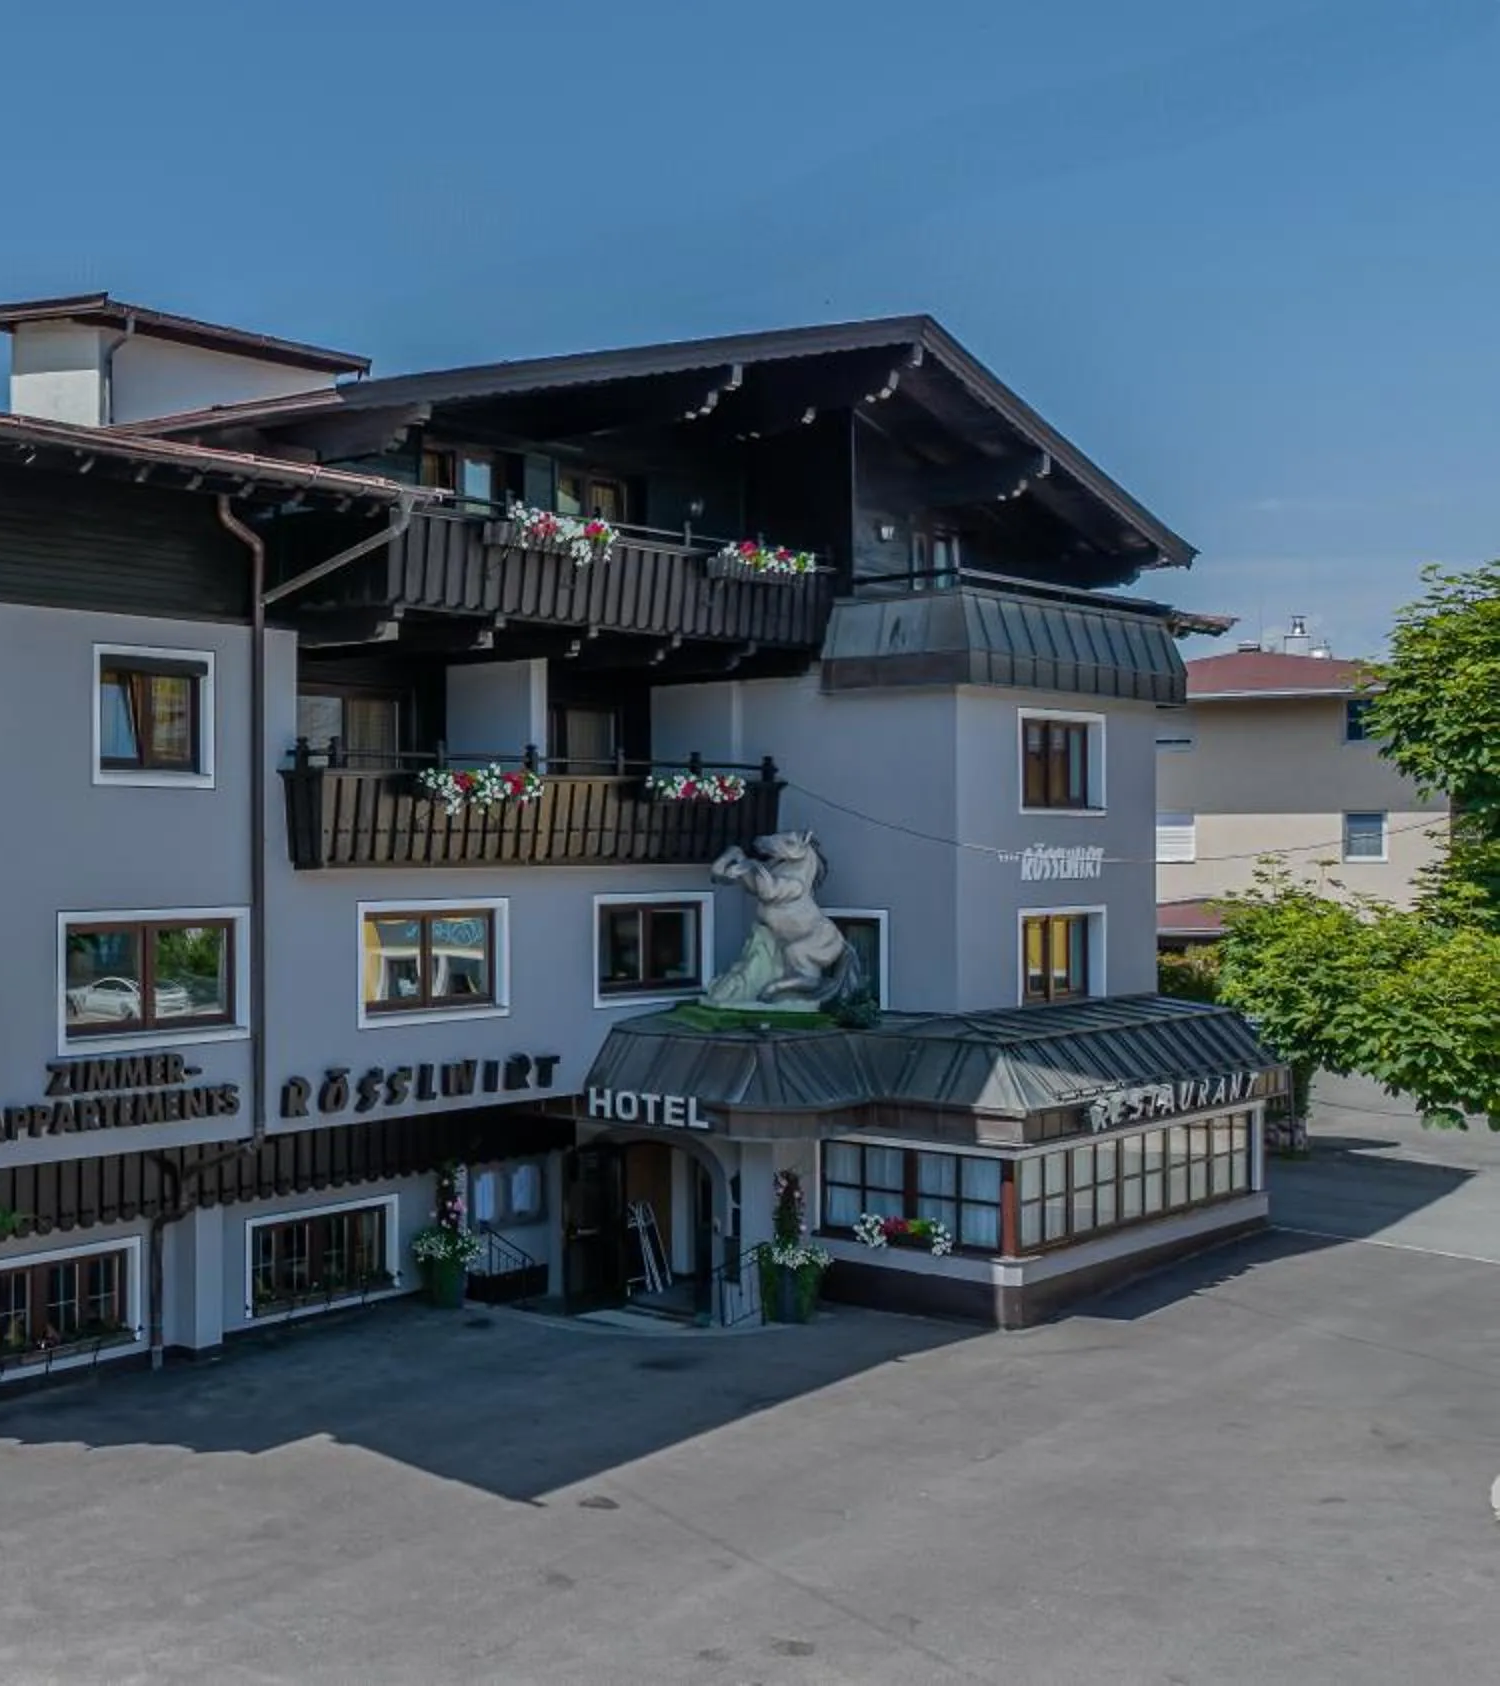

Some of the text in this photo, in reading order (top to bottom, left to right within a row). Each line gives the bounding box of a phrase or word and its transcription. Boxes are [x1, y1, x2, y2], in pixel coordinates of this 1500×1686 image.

[45, 1053, 202, 1096] ZIMMER-
[280, 1053, 560, 1118] RÖSSLWIRT
[589, 1087, 709, 1128] HOTEL
[1089, 1071, 1259, 1133] RESTAURANT
